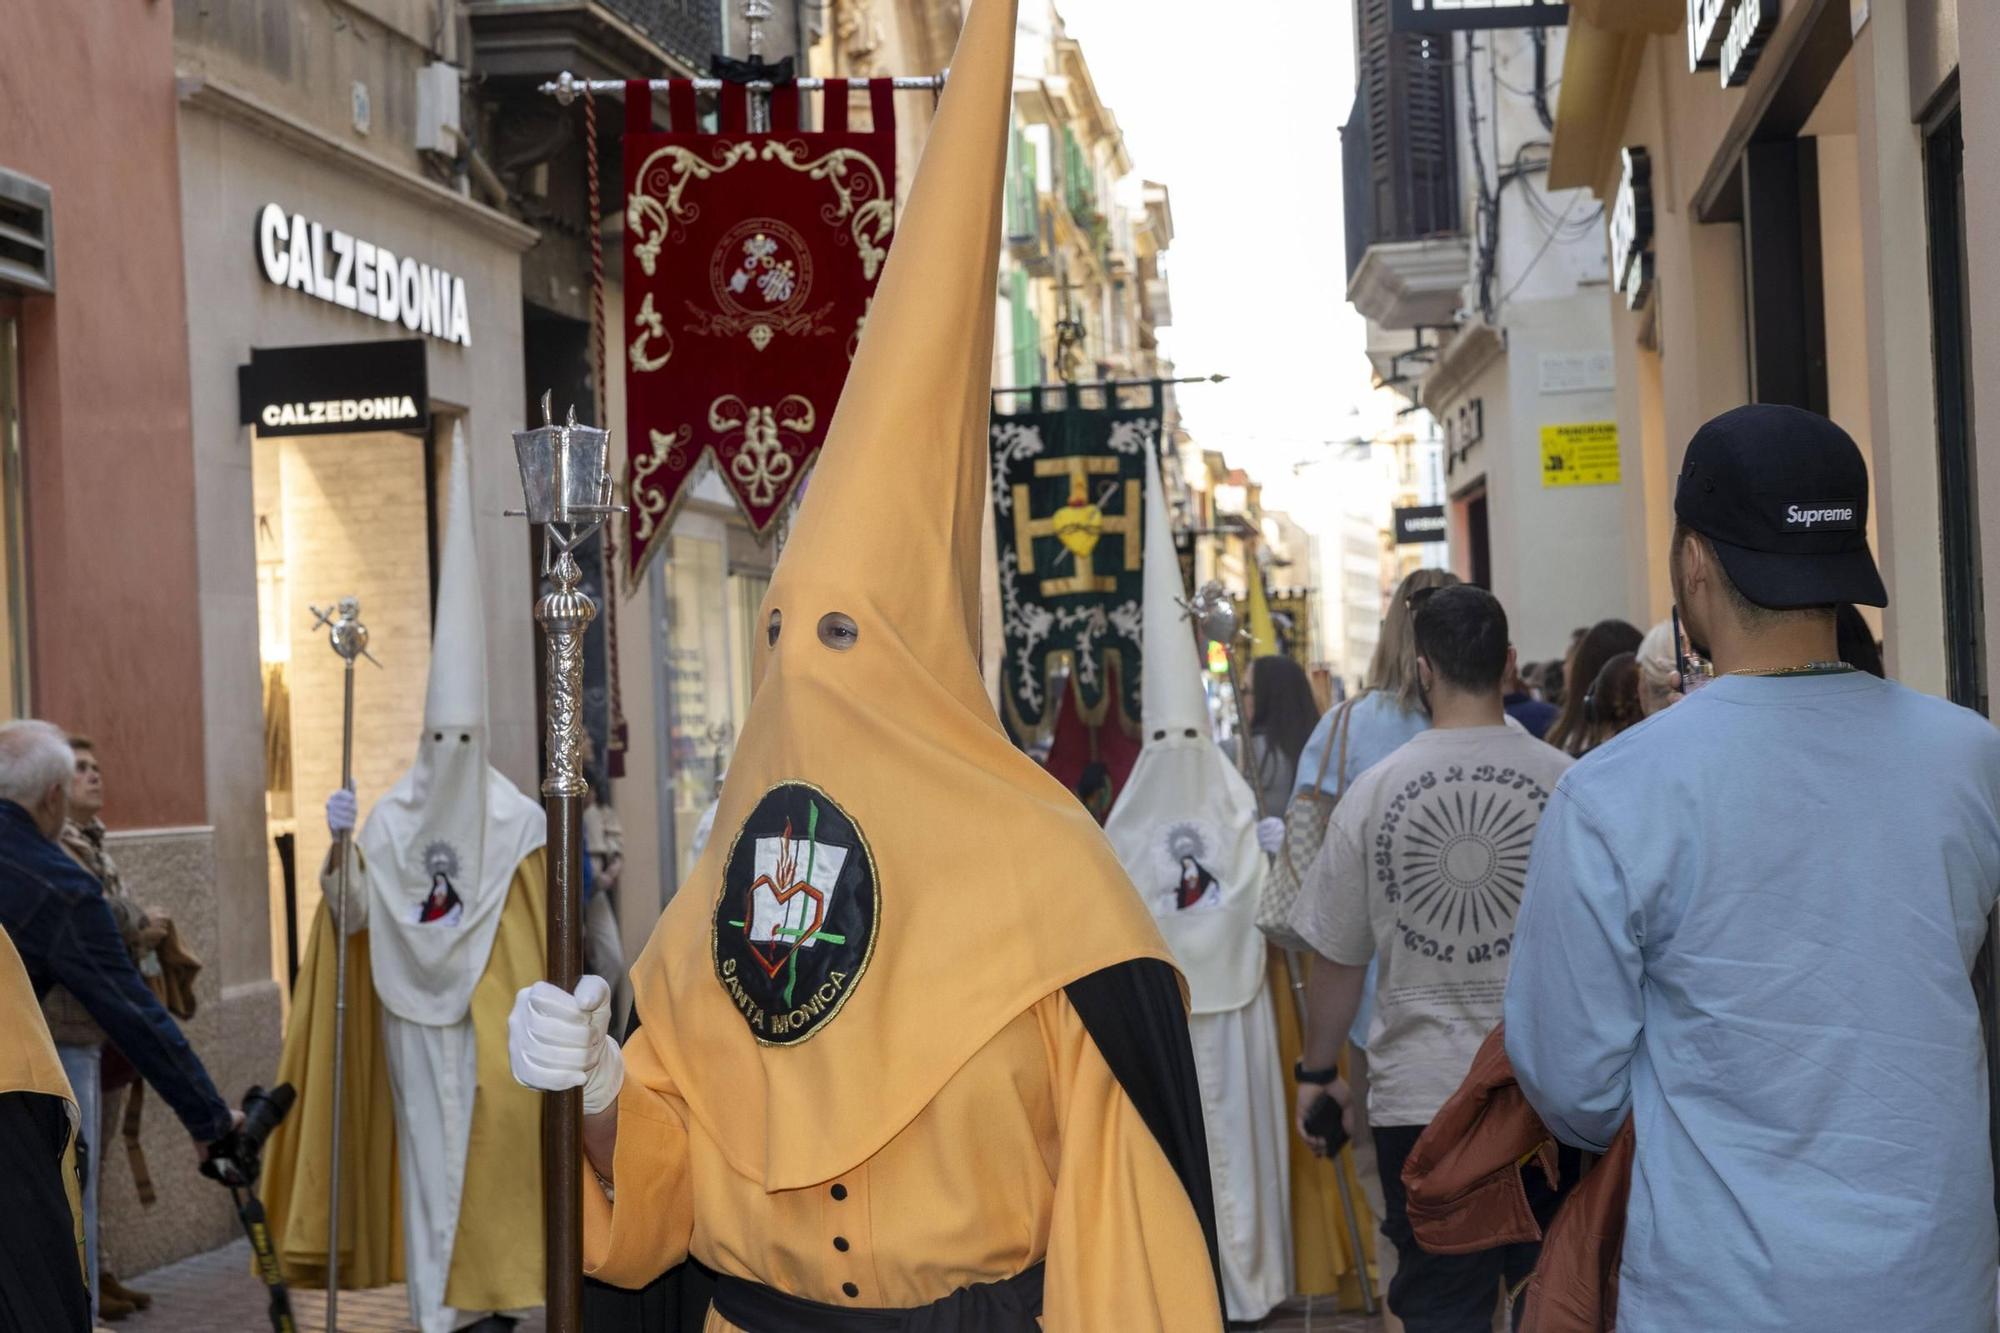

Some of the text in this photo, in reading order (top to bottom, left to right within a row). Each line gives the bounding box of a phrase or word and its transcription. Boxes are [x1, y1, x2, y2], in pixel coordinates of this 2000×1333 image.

[259, 202, 472, 347] CALZEDONIA
[262, 396, 418, 427] CALZEDONIA
[1786, 505, 1852, 527] Supreme
[1471, 765, 1549, 813] BETT
[722, 958, 849, 1034] SANTA MONICA
